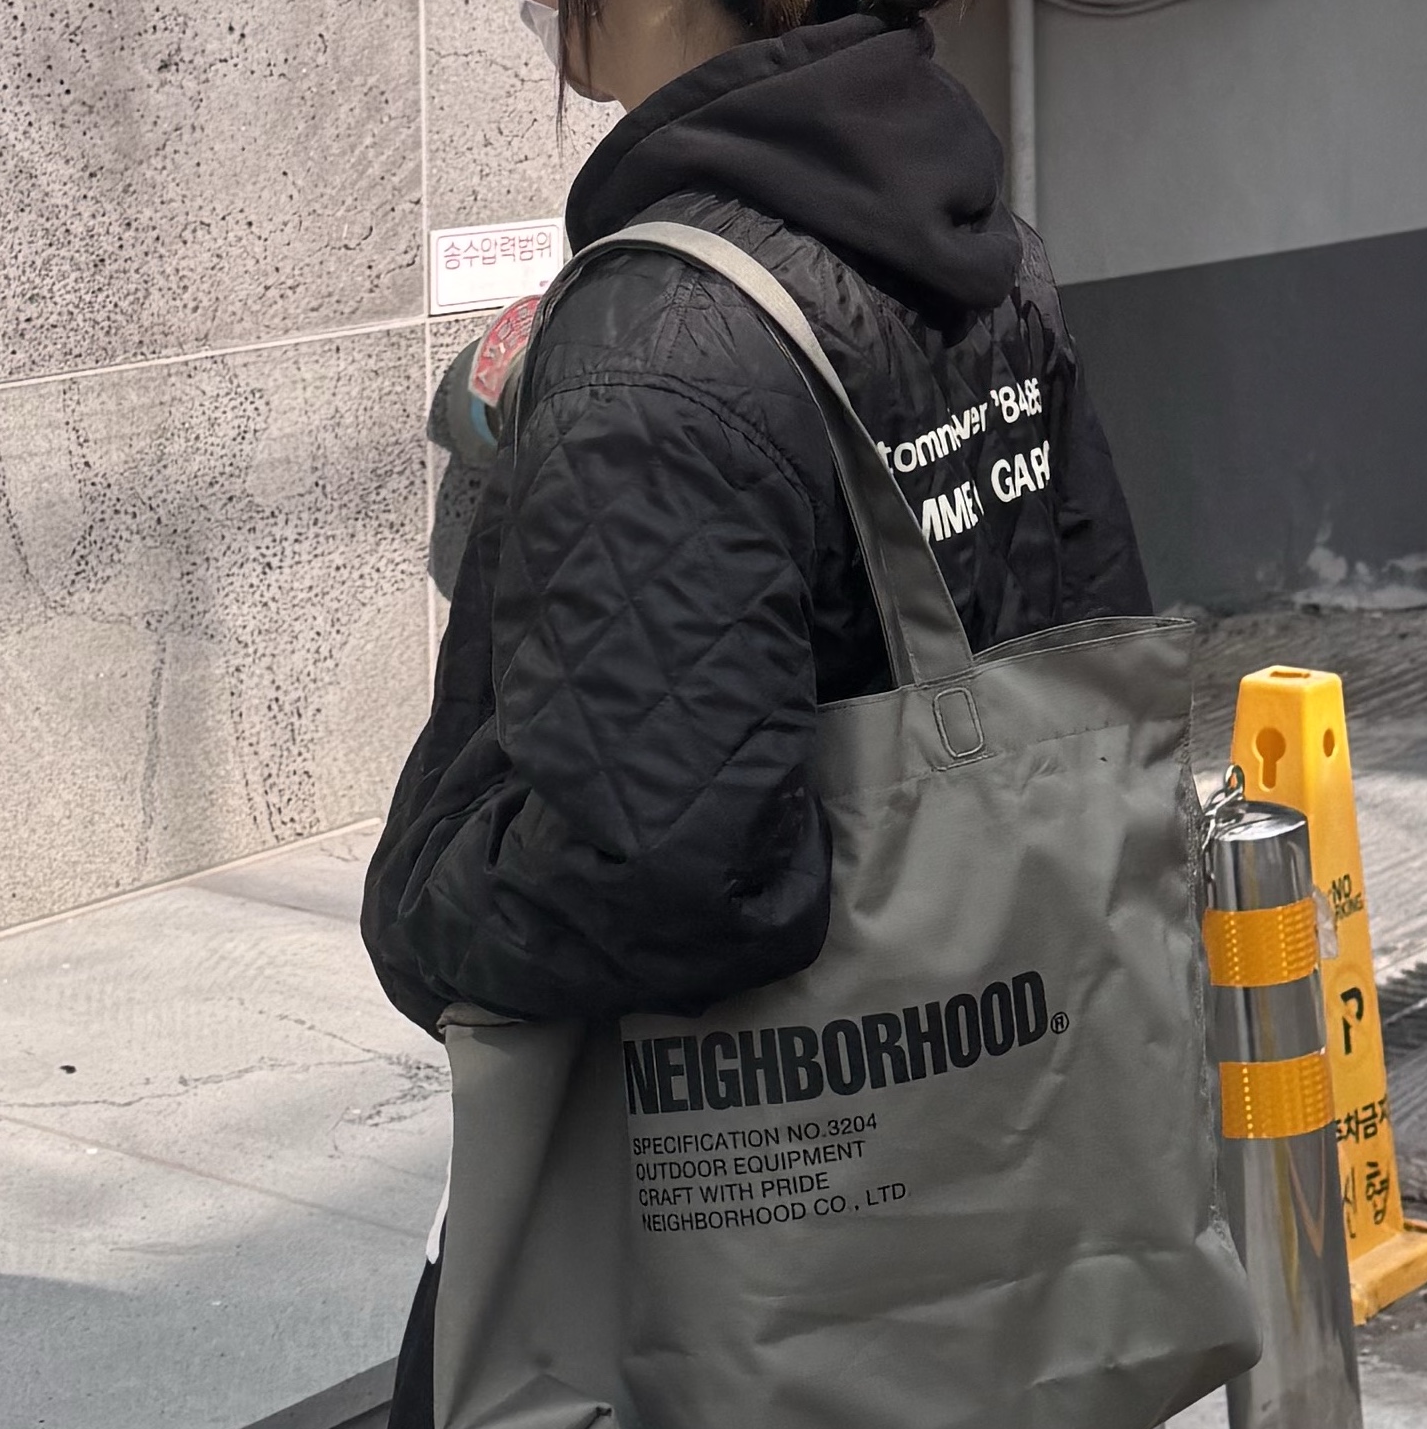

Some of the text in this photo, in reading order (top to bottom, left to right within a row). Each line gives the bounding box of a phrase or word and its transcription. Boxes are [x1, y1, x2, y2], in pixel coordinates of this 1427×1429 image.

[443, 231, 552, 270] 송수압력범위
[1331, 873, 1352, 905] NO
[632, 1111, 878, 1156] SPECIFICATION NO.3204
[635, 1138, 867, 1182] OUTDOOR EQUIPMENT
[638, 1171, 830, 1207] CRAFT WITH PRIDE
[641, 1200, 807, 1233] NEIGHBORHOOD
